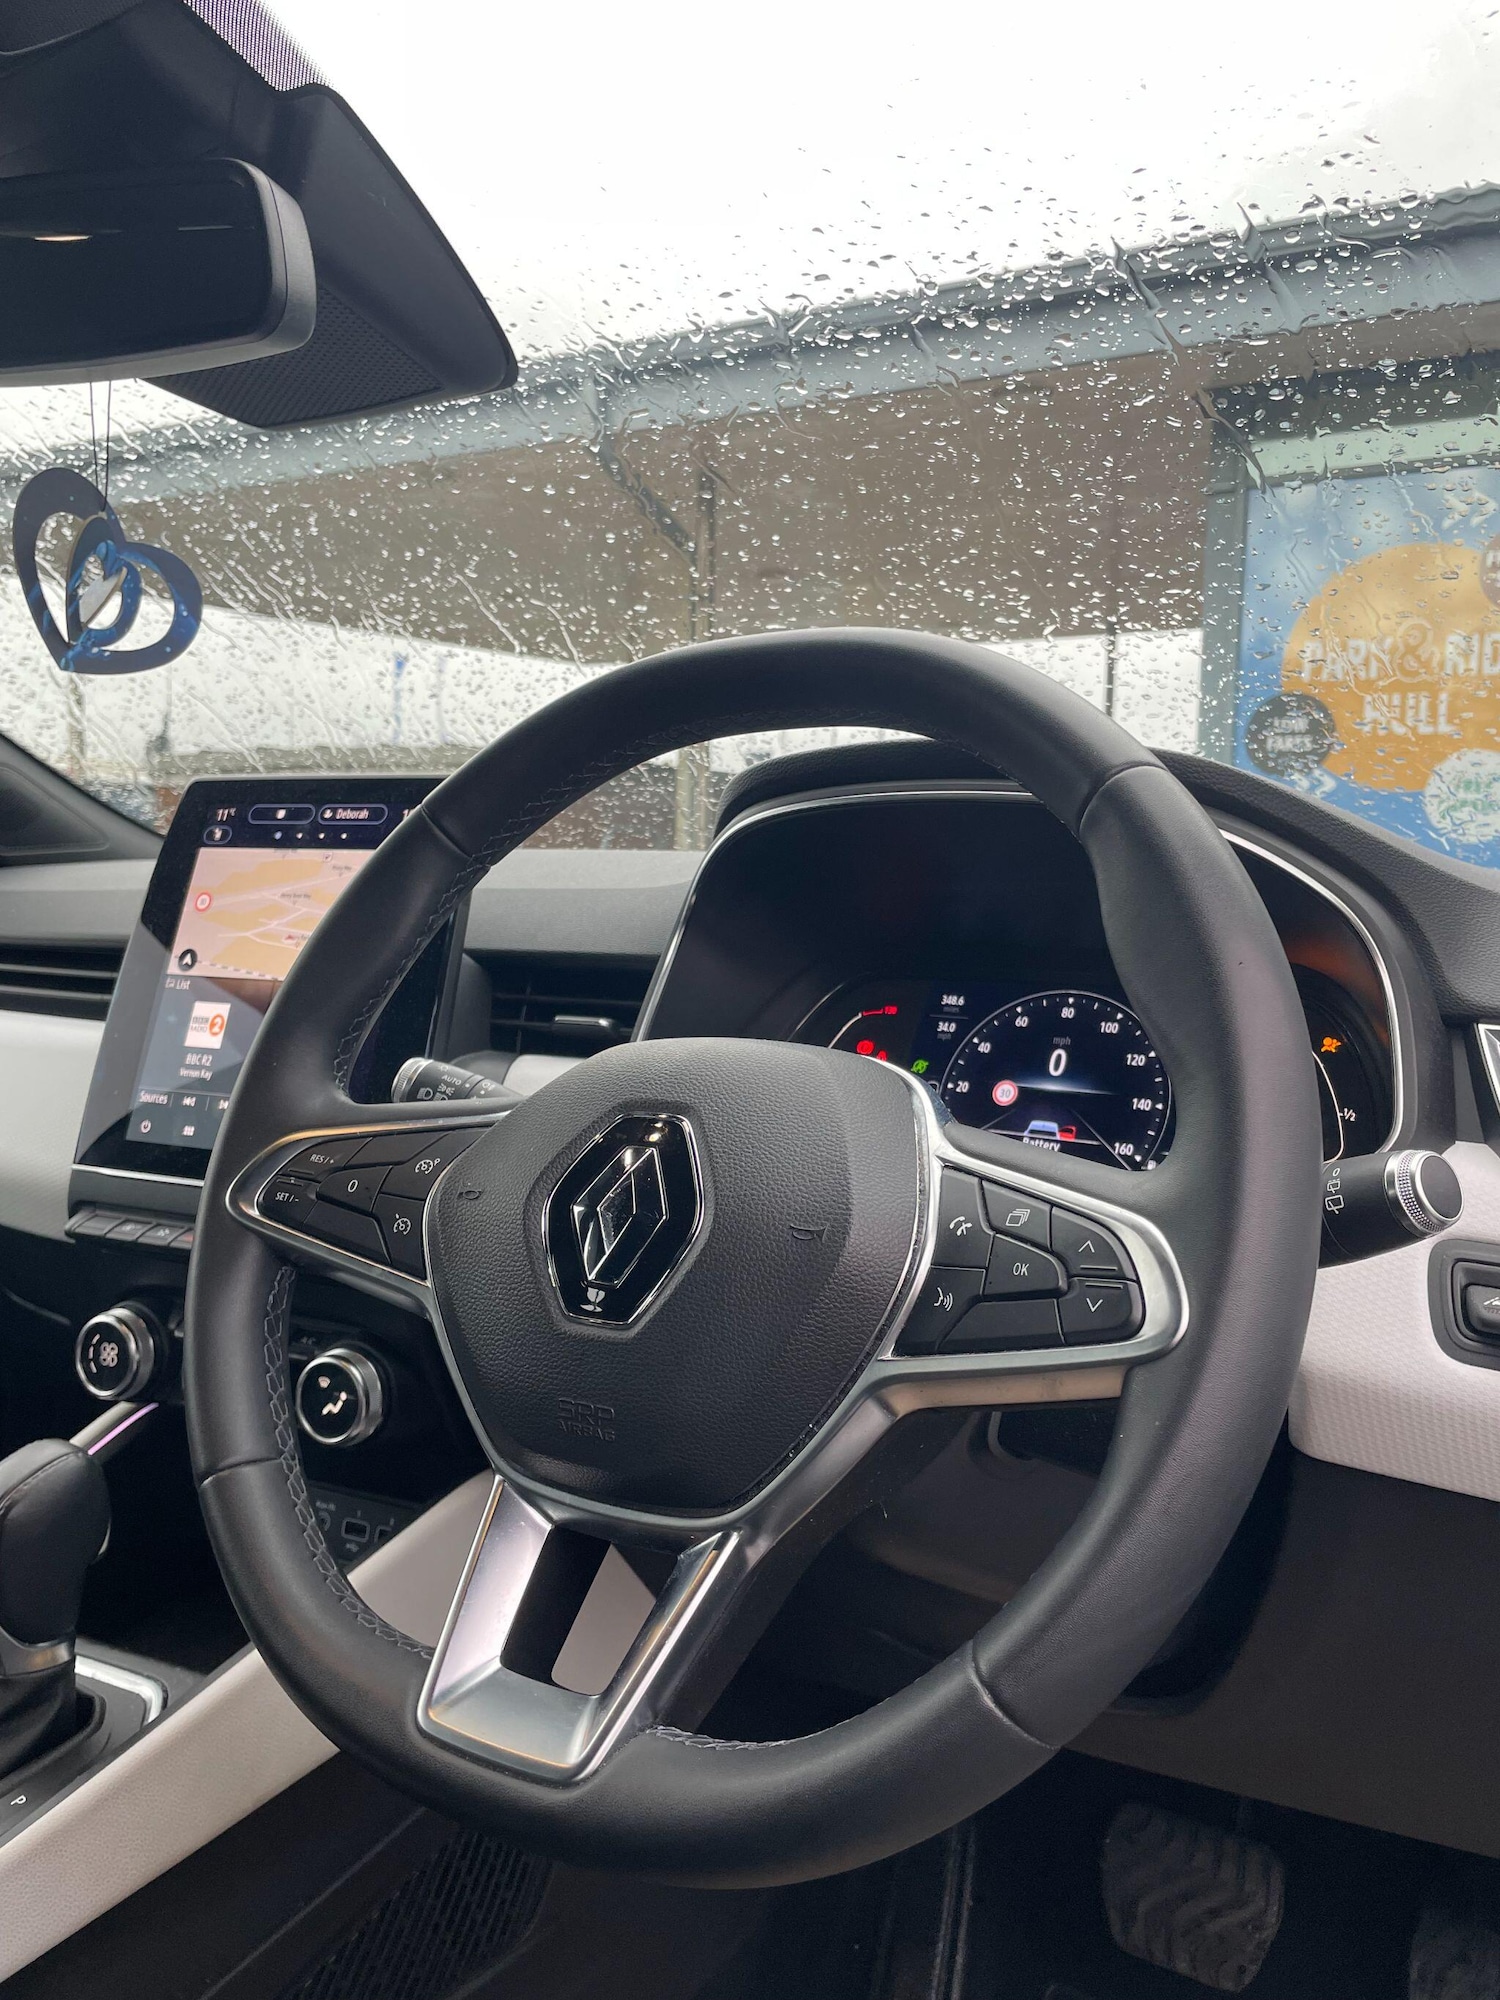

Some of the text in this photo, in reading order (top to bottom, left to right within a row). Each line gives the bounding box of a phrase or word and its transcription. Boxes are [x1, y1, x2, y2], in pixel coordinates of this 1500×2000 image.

[1301, 635, 1395, 684] PARK
[1393, 619, 1441, 684] &
[1362, 690, 1458, 736] HULL
[335, 808, 369, 820] Deborah
[176, 979, 190, 990] List
[941, 994, 965, 1006] 348.6
[1061, 1007, 1075, 1019] 80
[212, 1015, 223, 1035] 2
[937, 1021, 956, 1033] 34.0
[1015, 1015, 1029, 1028] 60
[1100, 1021, 1119, 1034] 100
[977, 1041, 991, 1054] 40
[1052, 1036, 1071, 1046] mph
[185, 1053, 212, 1066] BBC R2
[1049, 1048, 1066, 1077] 0
[1126, 1053, 1146, 1067] 120
[179, 1067, 213, 1081] Vernon Kay
[441, 1074, 462, 1086] AUTO
[955, 1081, 969, 1093] 20
[999, 1087, 1012, 1099] 30
[139, 1090, 168, 1105] Sources
[1132, 1098, 1152, 1111] 140
[1114, 1142, 1134, 1156] 160
[1012, 1262, 1030, 1276] OK
[10, 1794, 27, 1806] P
